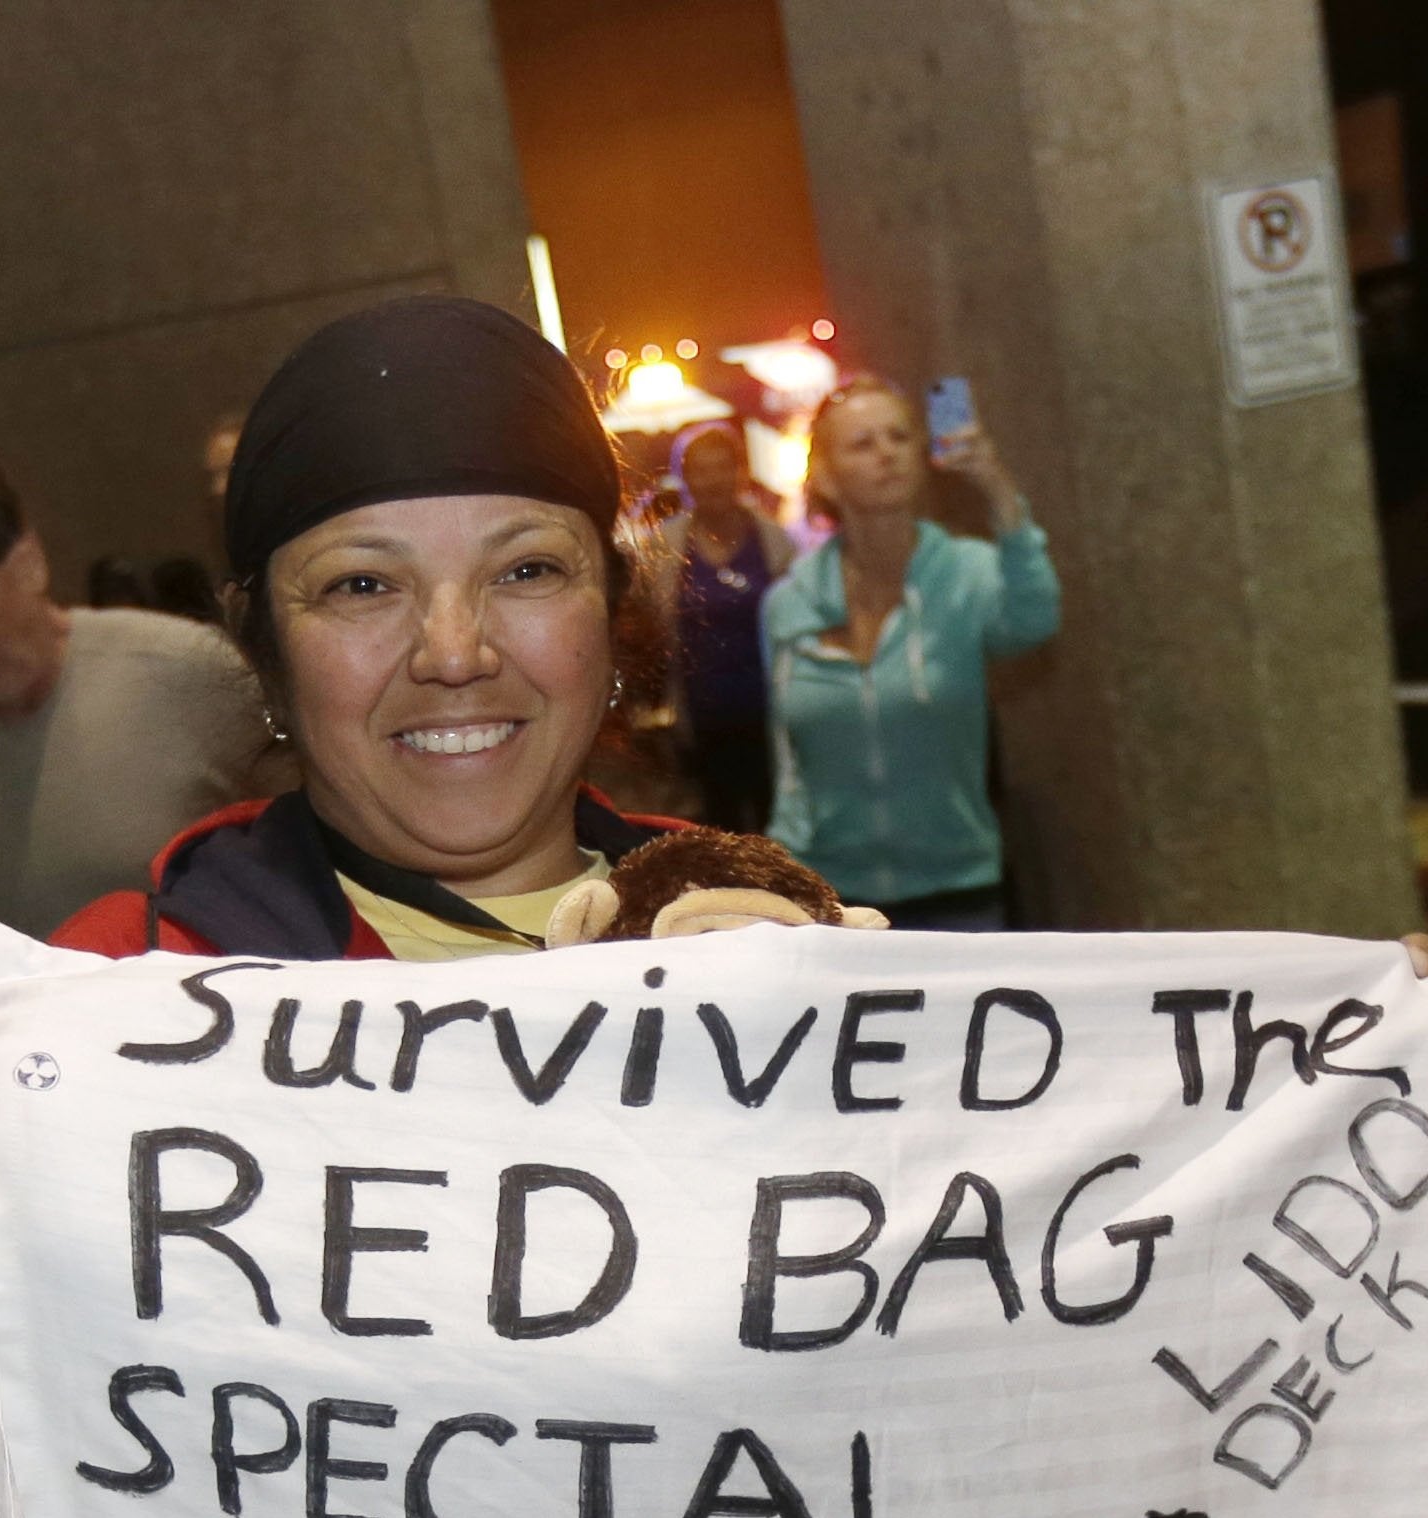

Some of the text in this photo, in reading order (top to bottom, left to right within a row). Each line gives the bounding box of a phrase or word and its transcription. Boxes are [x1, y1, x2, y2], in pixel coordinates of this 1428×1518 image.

[1152, 988, 1411, 1112] The
[128, 1126, 1173, 1353] RED BAG
